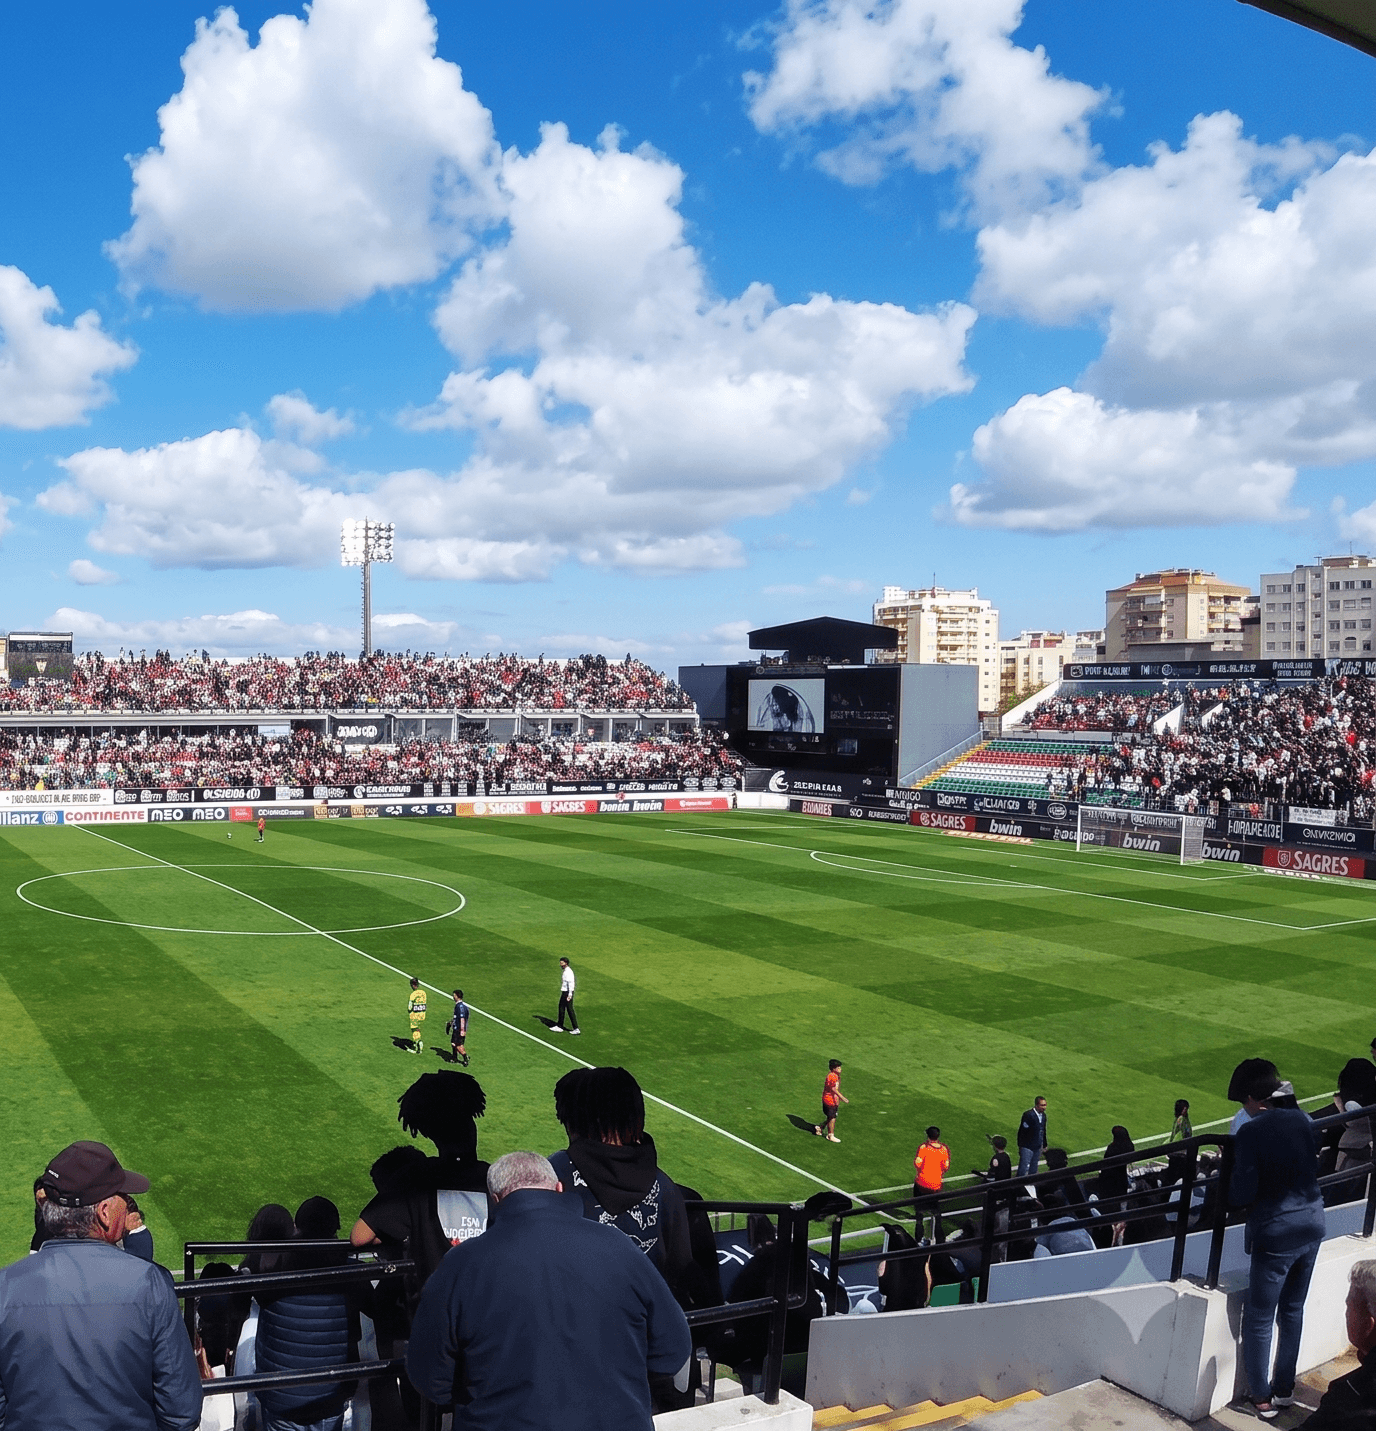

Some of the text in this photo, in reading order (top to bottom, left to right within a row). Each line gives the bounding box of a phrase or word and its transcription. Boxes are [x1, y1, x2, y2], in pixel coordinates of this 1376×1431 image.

[65, 811, 145, 822] CONTINENTE
[151, 808, 225, 820] MEO MEO
[930, 812, 966, 829] SAGRES
[1201, 842, 1241, 862] bwin
[1292, 850, 1349, 876] SAGRES
